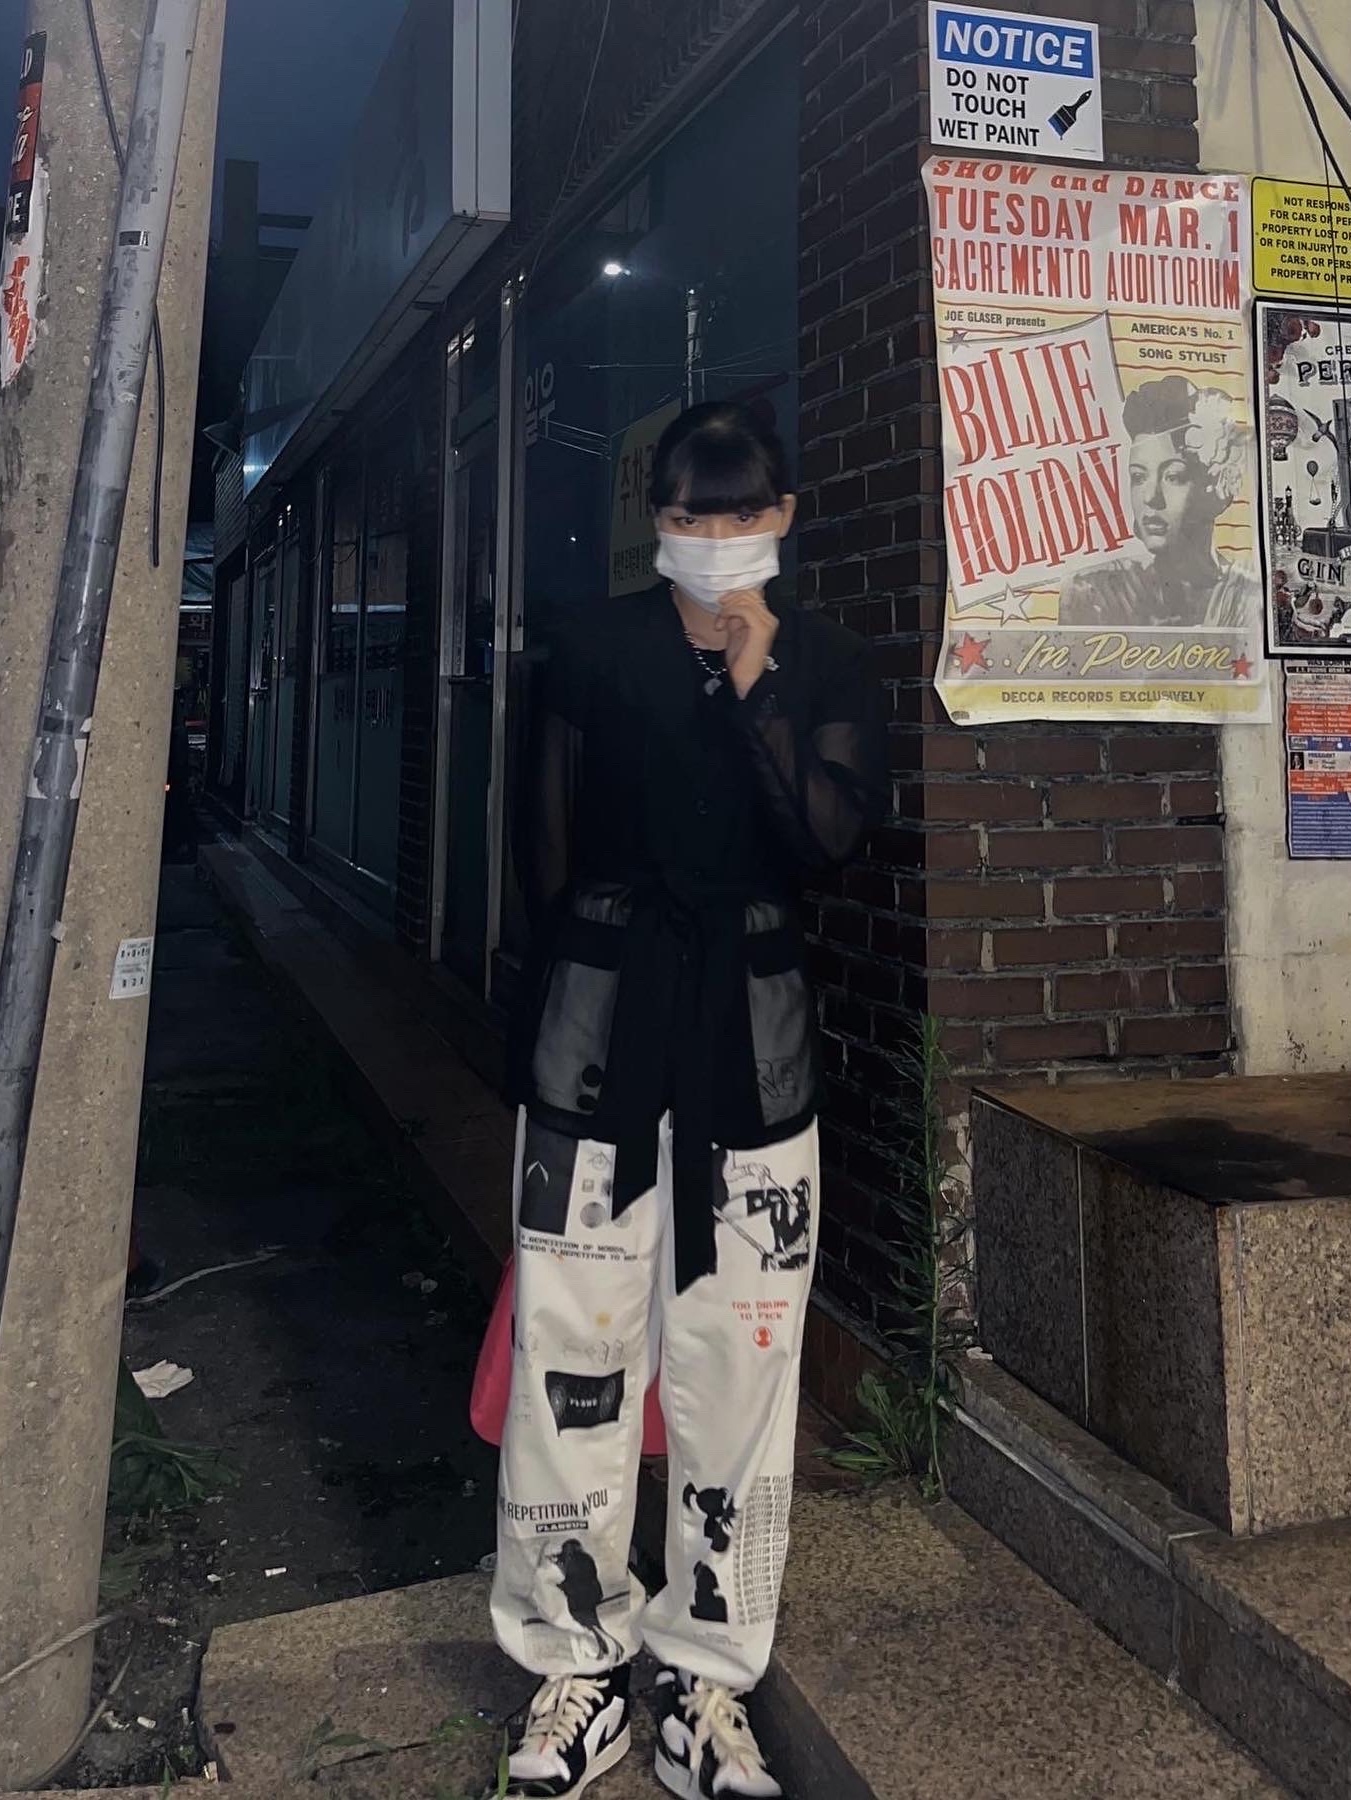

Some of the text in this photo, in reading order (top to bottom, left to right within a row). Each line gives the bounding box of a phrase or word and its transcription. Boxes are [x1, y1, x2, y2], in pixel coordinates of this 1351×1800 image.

[944, 19, 1086, 70] NOTICE
[946, 68, 1029, 95] DO NOT
[952, 92, 1026, 119] TOUCH
[938, 118, 1040, 147] WET PAINT
[932, 159, 1240, 202] SHOW and DANCE
[1270, 209, 1289, 219] FOR
[1292, 212, 1317, 223] CARS
[1284, 196, 1350, 211] NOT RESPONS
[933, 185, 1239, 252] TUESDAY MAR. 1
[1262, 223, 1312, 236] PROPERTY
[1315, 229, 1338, 239] LOST
[1260, 237, 1348, 254] OR FOR INJURY TO
[933, 236, 1241, 310] SACREMENTO AUDITORIUM
[1281, 254, 1309, 267] CARS,
[1311, 257, 1324, 267] OR
[1271, 268, 1321, 280] PROPERTY
[1324, 273, 1336, 282] ON
[944, 310, 1046, 328] JOE GLASER presents
[1131, 323, 1234, 340] AMERICA'S No. 1
[1139, 348, 1228, 364] SONG STYLIST
[942, 340, 1109, 466] BILLIE
[945, 443, 1134, 586] HOLIDAY
[1298, 558, 1344, 584] GIN
[1017, 633, 1232, 675] In Person
[1001, 690, 1205, 703] DECCA RECORDS EXCLUSIVELY
[507, 1501, 579, 1522] REPETITION
[586, 1488, 608, 1509] YOU
